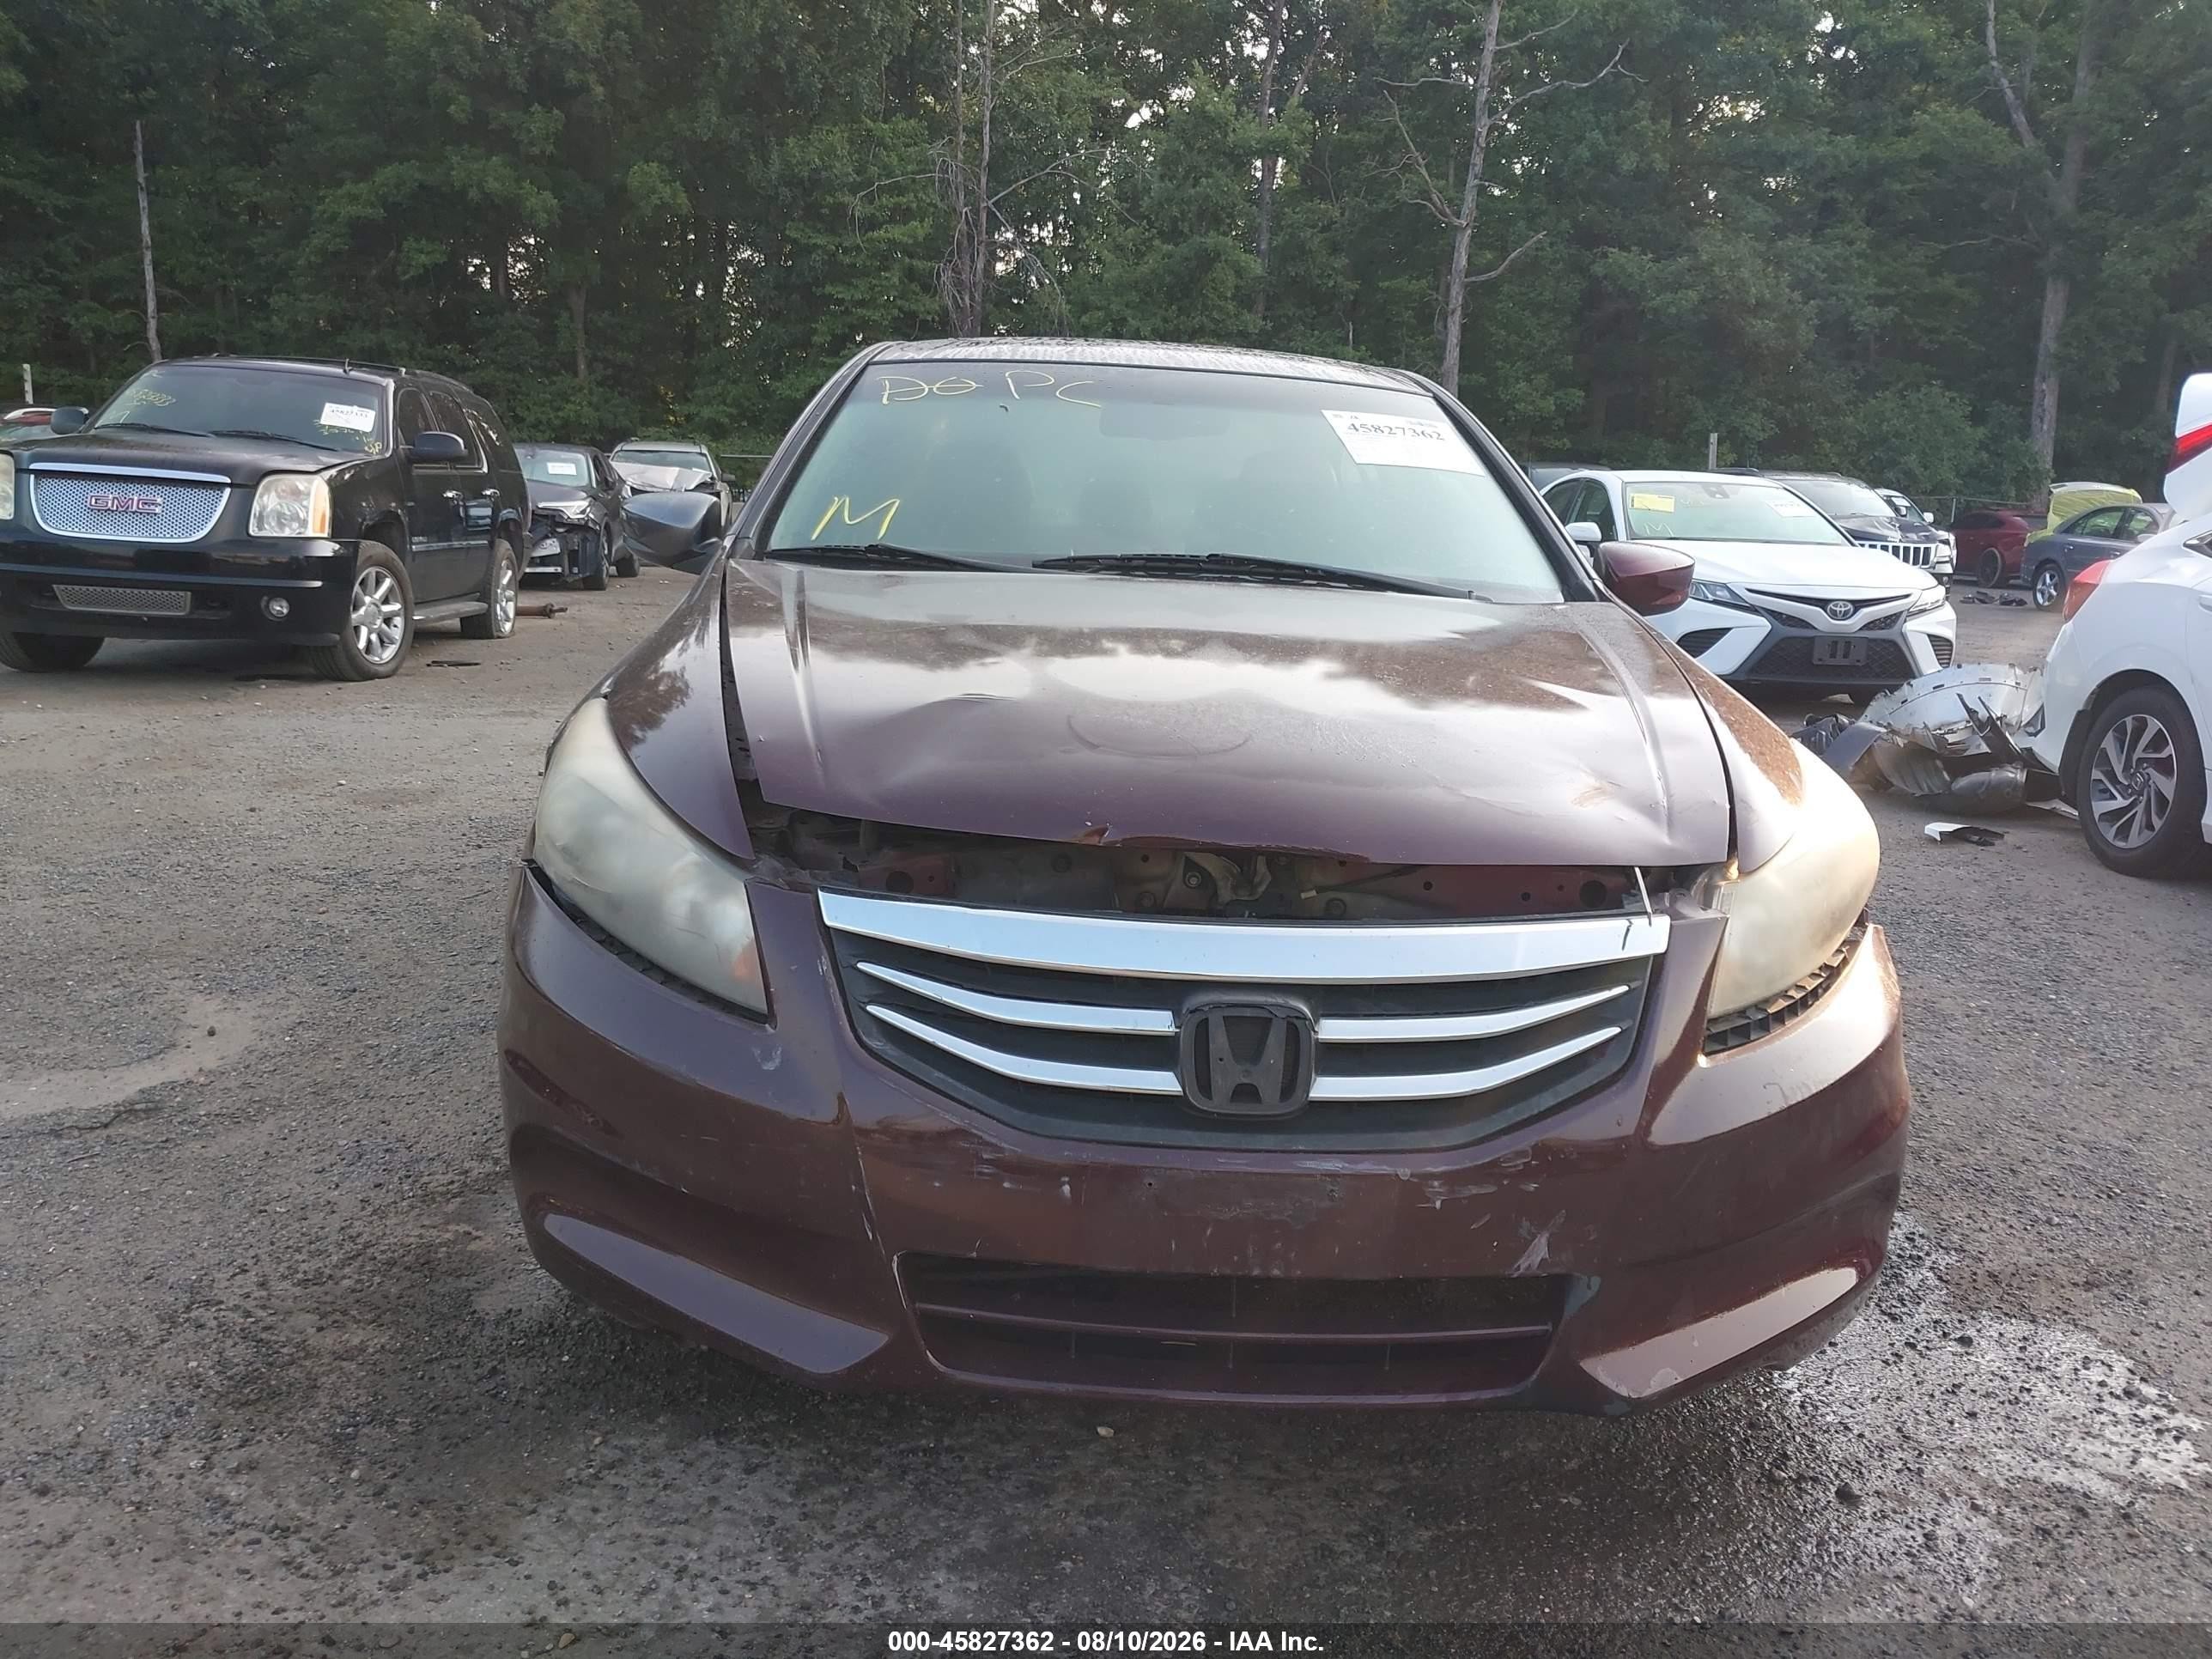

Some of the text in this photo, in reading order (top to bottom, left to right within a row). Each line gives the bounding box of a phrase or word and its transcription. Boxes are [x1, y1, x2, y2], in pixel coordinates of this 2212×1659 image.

[1347, 422, 1446, 441] 45827362
[88, 495, 161, 514] GMC
[810, 495, 901, 541] M
